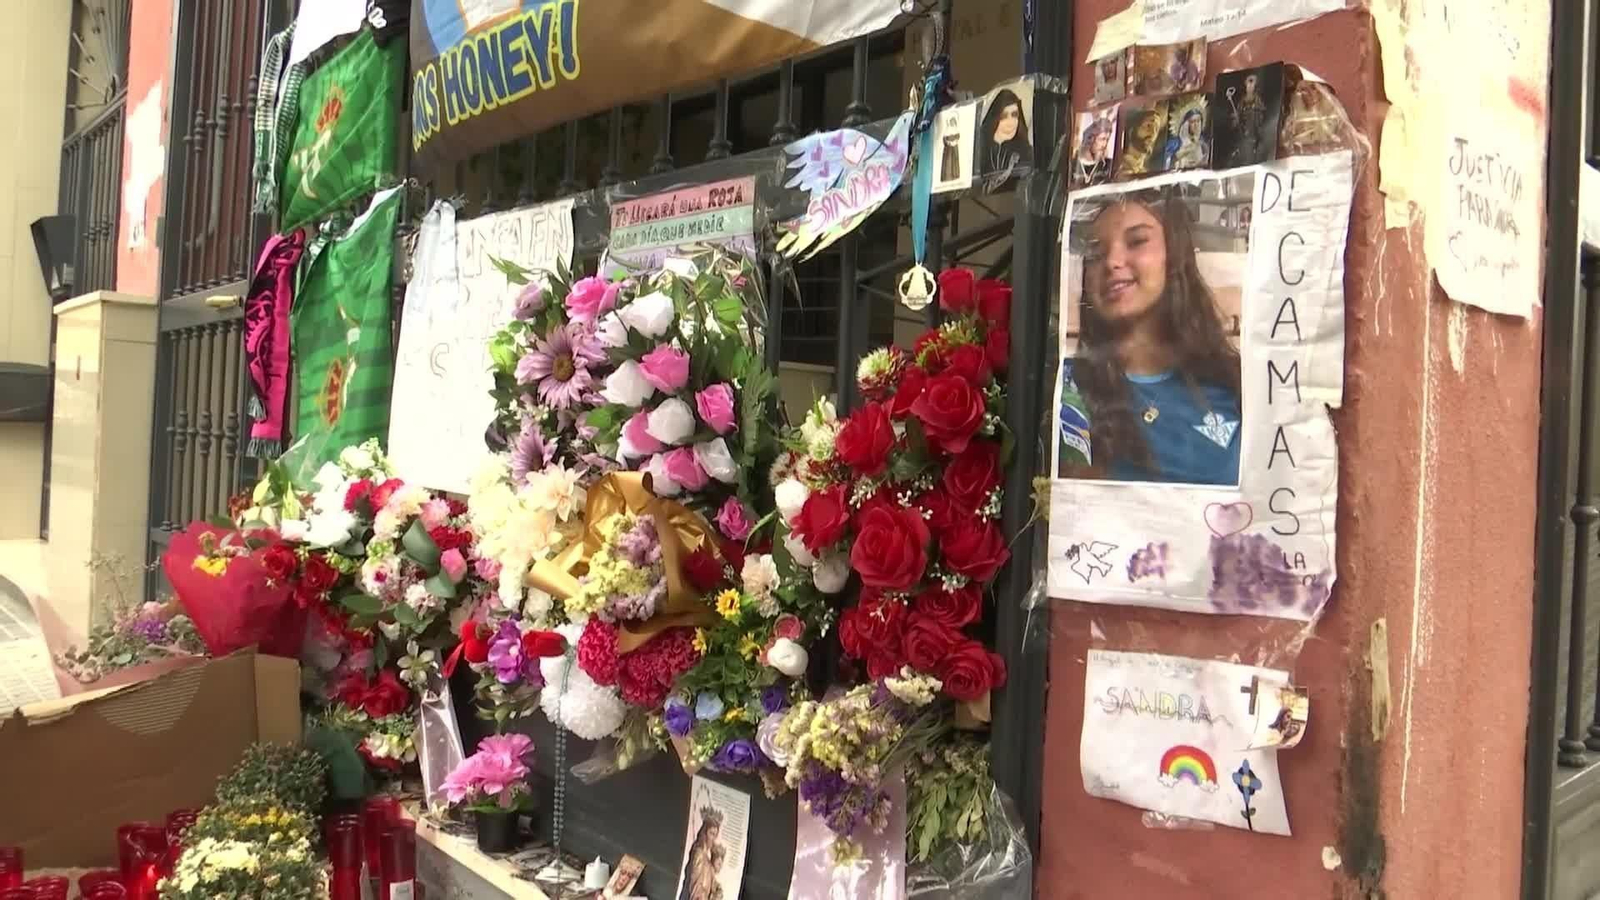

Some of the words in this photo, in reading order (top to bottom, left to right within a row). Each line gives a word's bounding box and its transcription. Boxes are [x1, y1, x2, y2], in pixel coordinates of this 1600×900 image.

[412, 63, 440, 152] OS
[440, 0, 580, 126] HONEY!
[1261, 170, 1314, 213] DE
[1267, 231, 1305, 536] CAMAS
[1102, 686, 1214, 726] SANDRA
